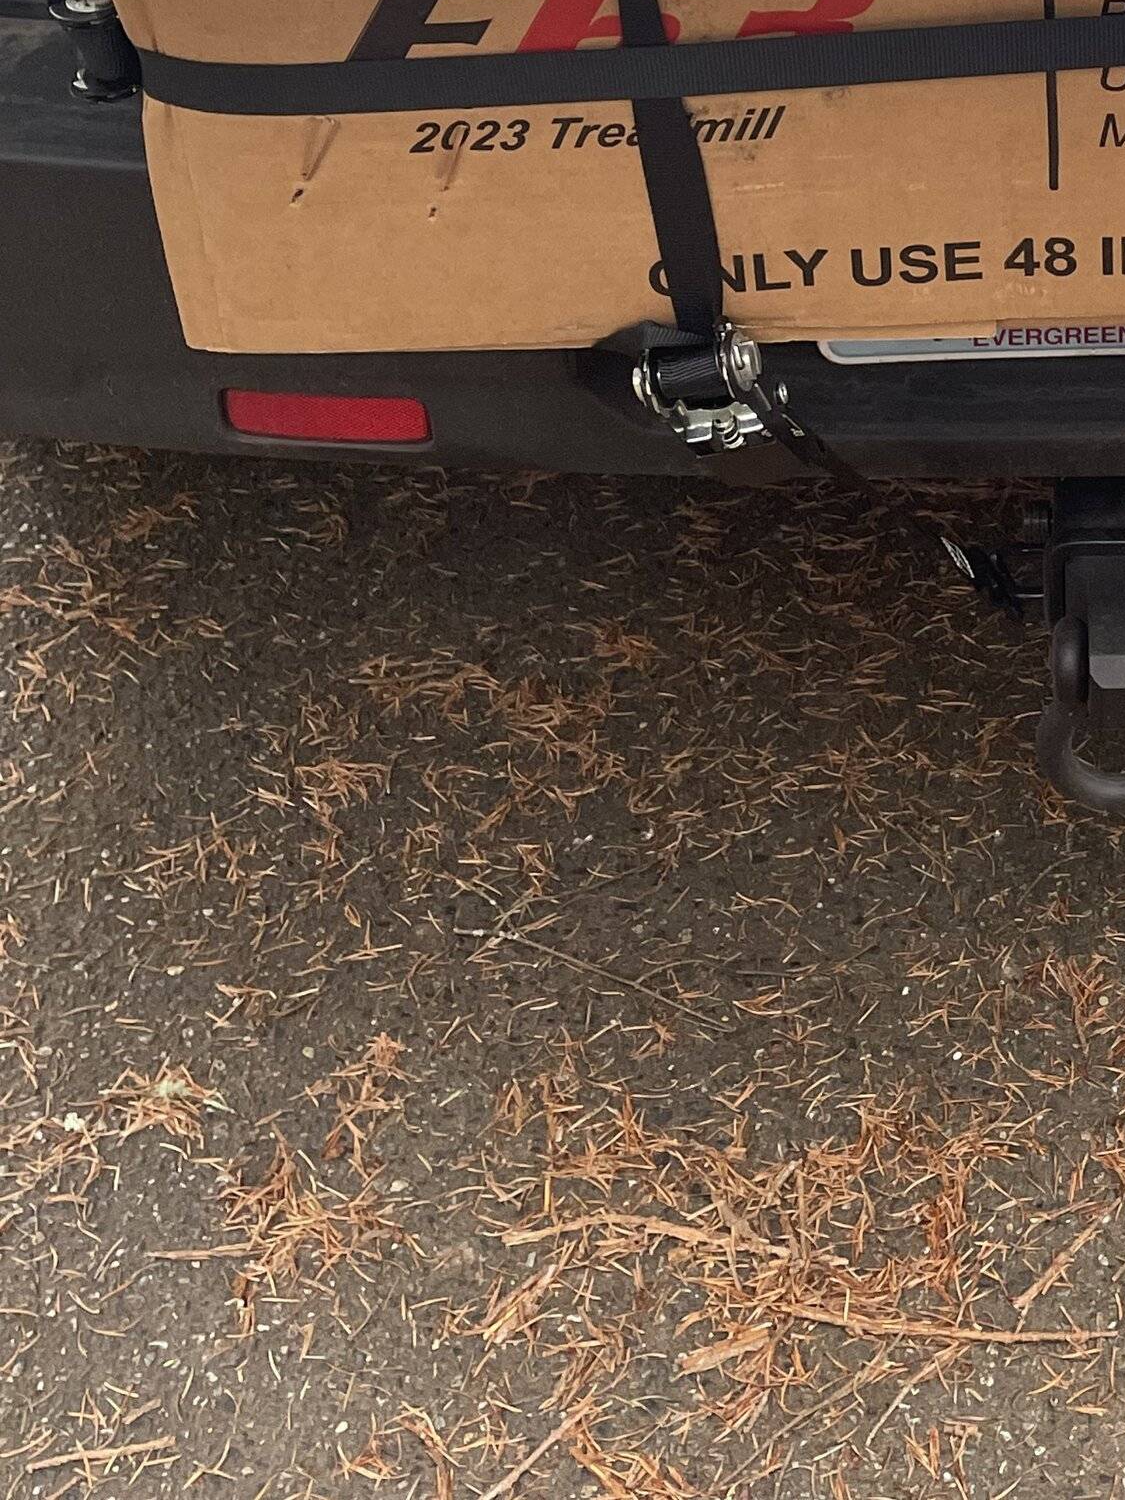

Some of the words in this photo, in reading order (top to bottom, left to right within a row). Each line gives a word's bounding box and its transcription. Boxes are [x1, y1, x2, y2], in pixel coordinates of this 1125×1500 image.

[409, 119, 531, 154] 2023
[550, 105, 787, 150] Treamill
[851, 241, 984, 287] USE
[1003, 236, 1078, 278] 48
